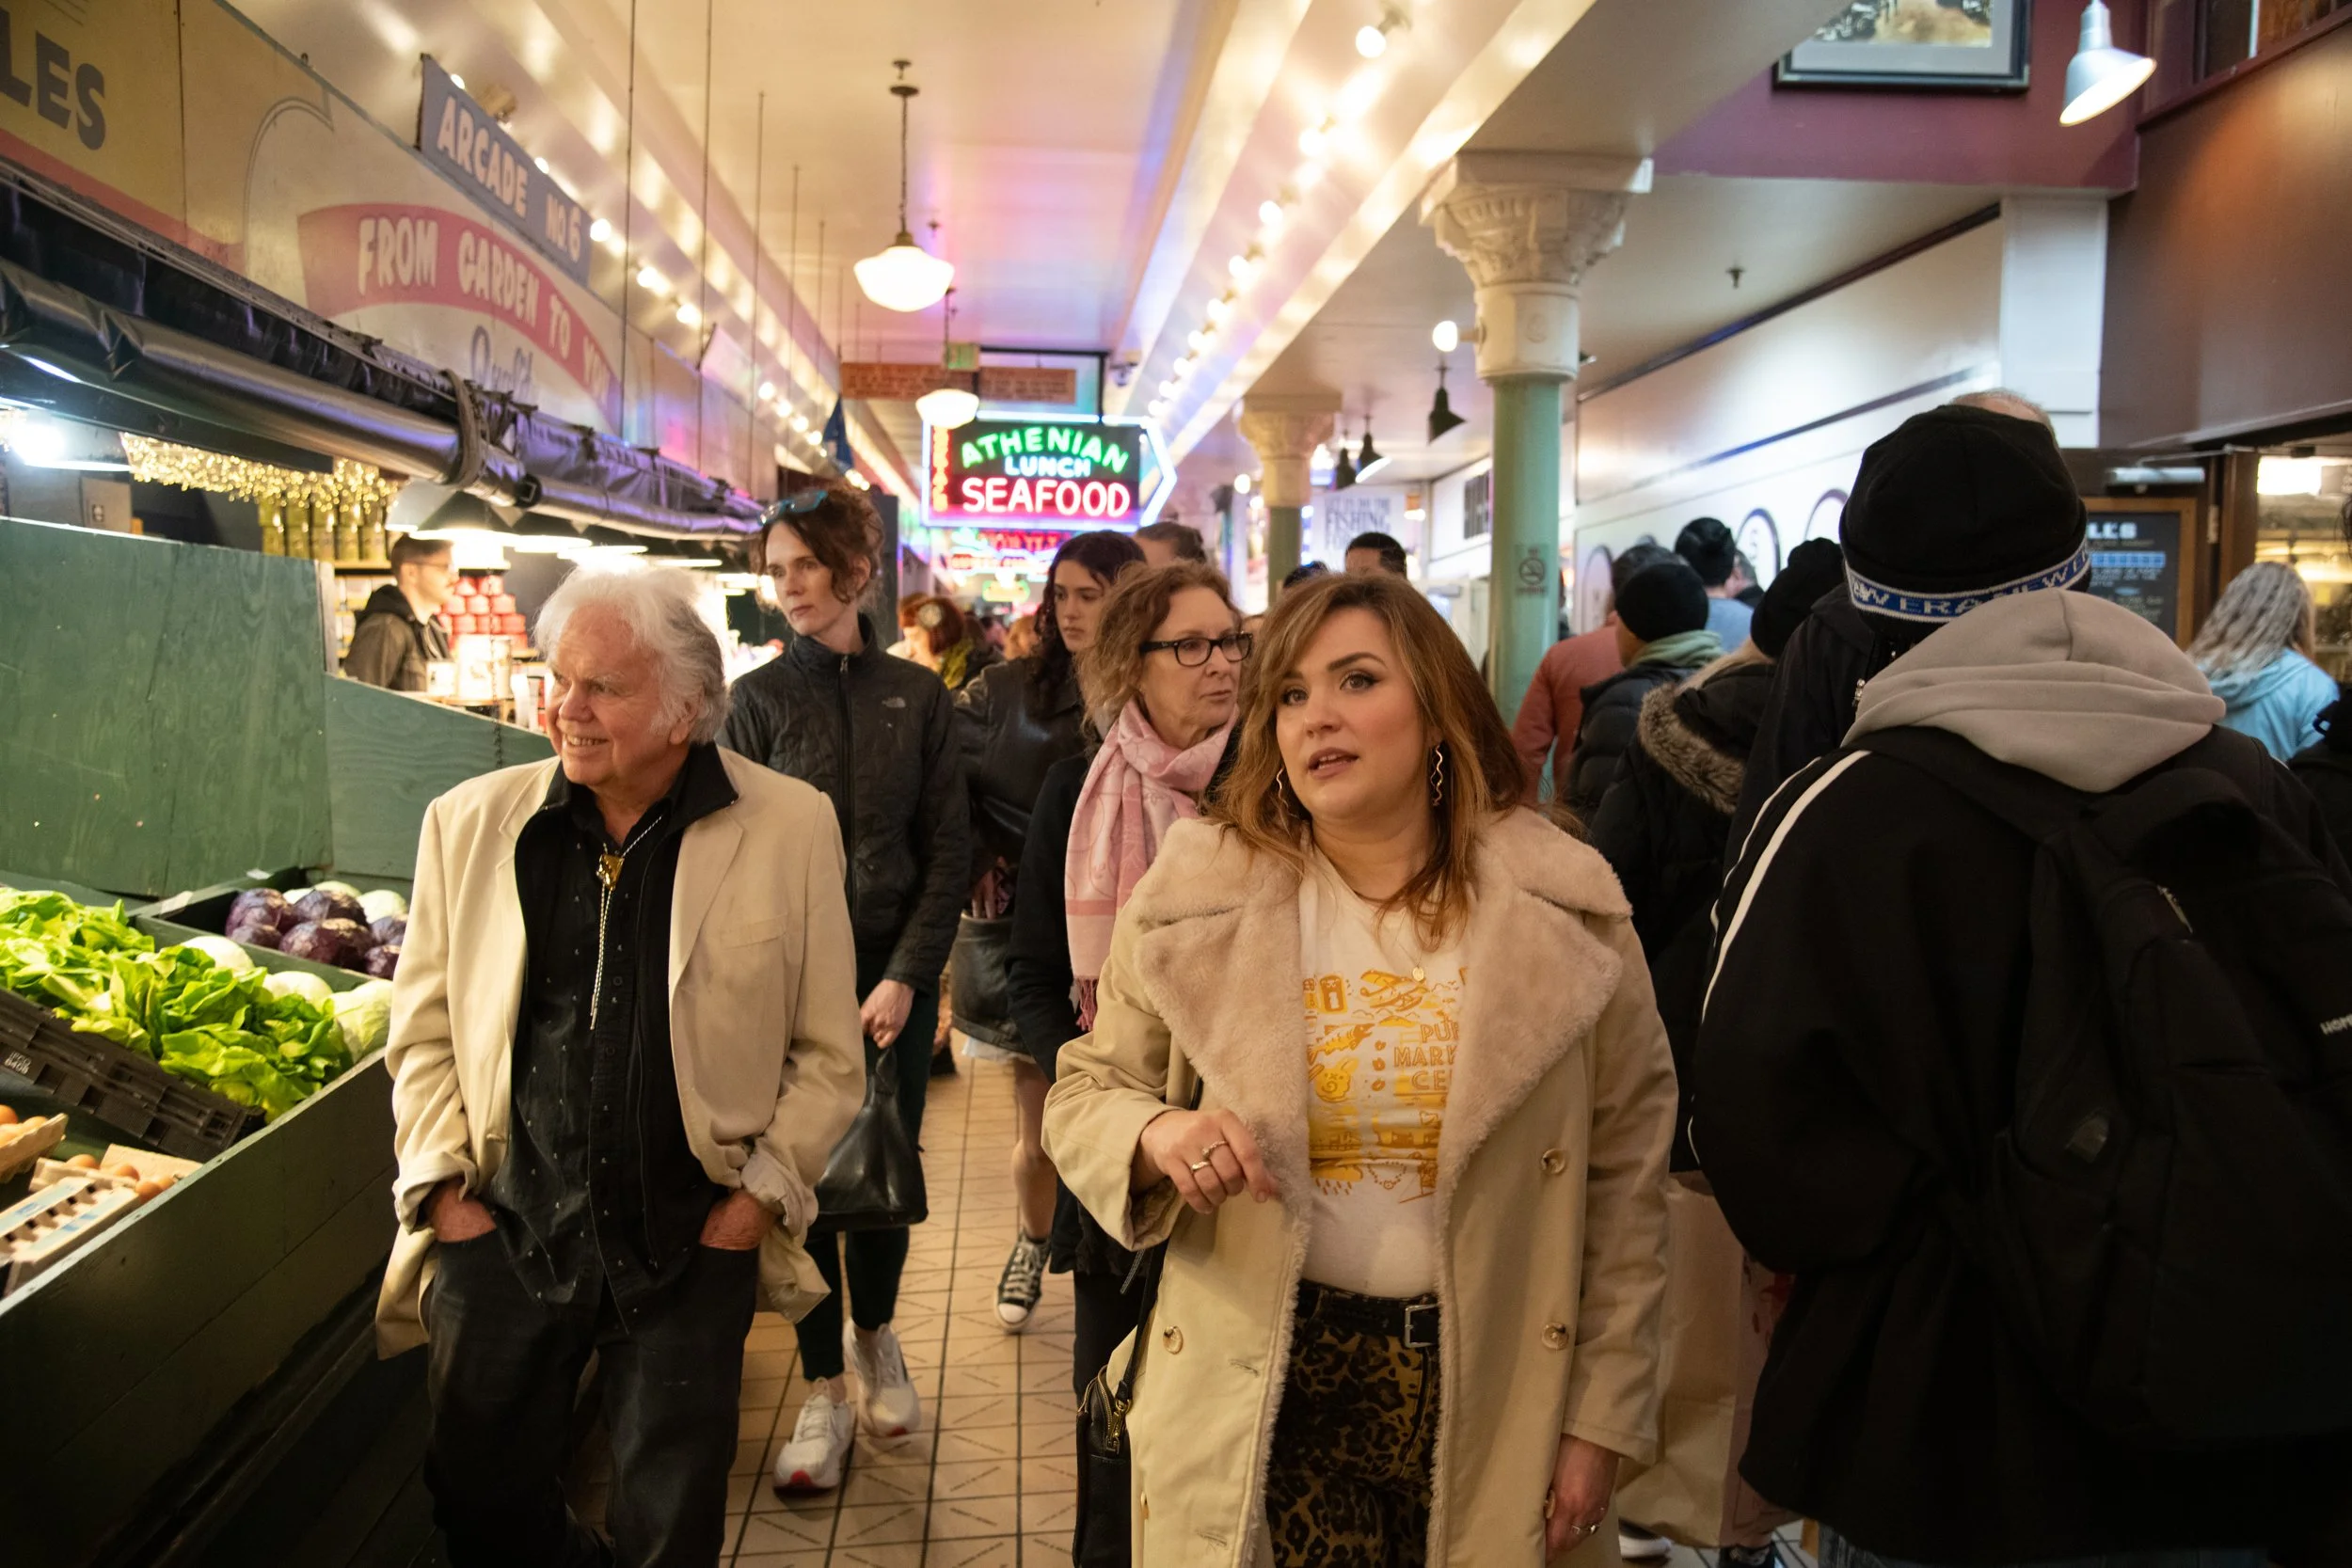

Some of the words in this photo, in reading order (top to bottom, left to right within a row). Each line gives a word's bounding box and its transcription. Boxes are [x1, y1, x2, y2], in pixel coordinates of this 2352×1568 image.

[437, 96, 529, 218] ARCADE
[569, 206, 581, 262] 6
[358, 216, 439, 296] FROM
[457, 230, 540, 327] GARDEN
[548, 294, 571, 359] TO
[961, 426, 1129, 473] ATHENIAN
[1004, 455, 1091, 478] LUNCH
[961, 477, 1131, 517] SEAFOOD
[1325, 509, 1391, 533] FISHING
[1412, 1069, 1453, 1090] CE
